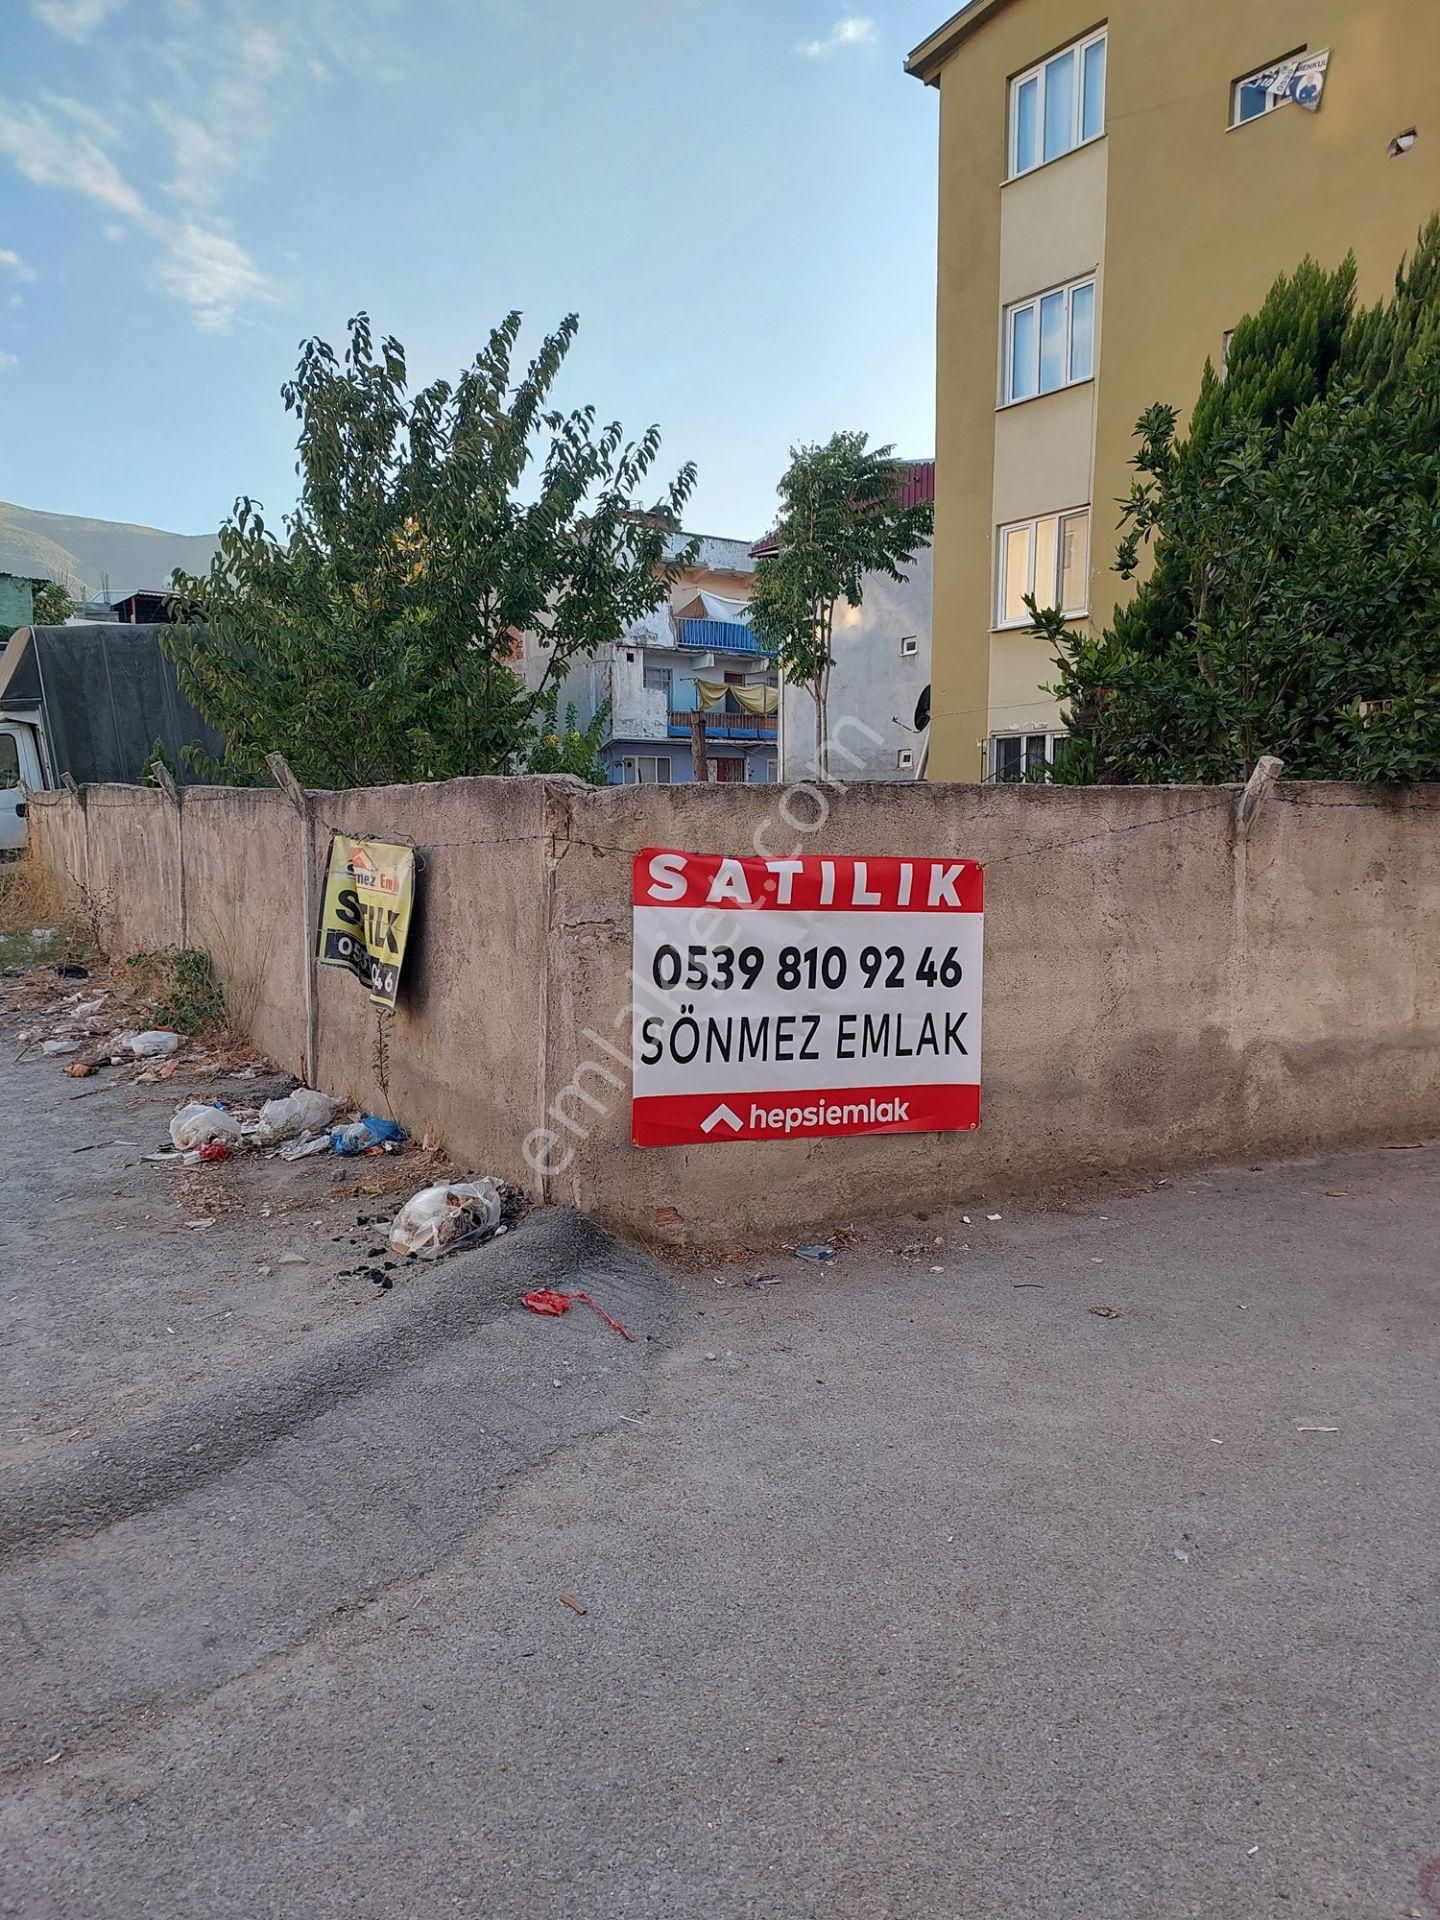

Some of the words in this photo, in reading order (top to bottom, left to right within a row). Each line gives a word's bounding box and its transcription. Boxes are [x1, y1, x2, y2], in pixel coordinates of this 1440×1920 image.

[647, 853, 966, 908] SATILIK
[652, 944, 765, 991] 0539
[776, 946, 847, 990] 810
[859, 946, 905, 989] 92
[915, 946, 963, 988] 46
[640, 1004, 820, 1066] SÖNMEZ
[836, 1011, 969, 1059] EMLAK
[749, 1097, 910, 1133] hepsiemlak
